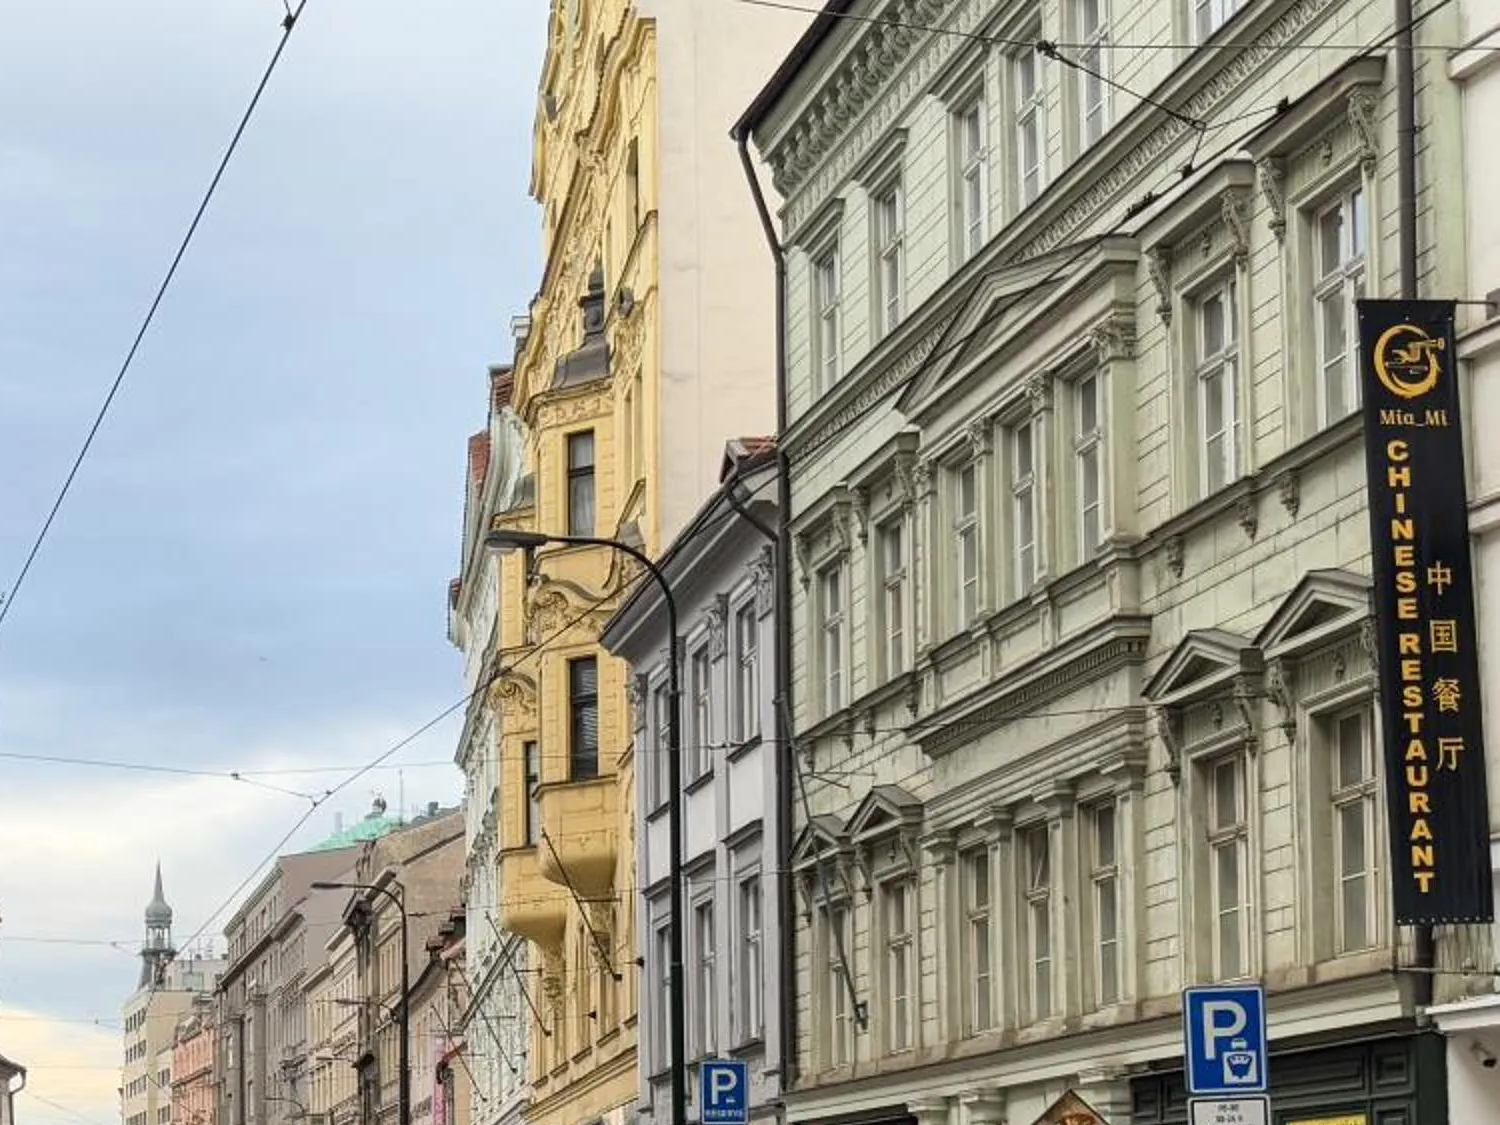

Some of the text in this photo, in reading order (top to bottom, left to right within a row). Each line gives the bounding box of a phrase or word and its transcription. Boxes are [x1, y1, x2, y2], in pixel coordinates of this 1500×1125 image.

[1379, 407, 1449, 428] Mia_Mi
[1387, 439, 1436, 893] CHINESE RESTAURANT
[1426, 560, 1466, 772] 中国餐厅
[1203, 1000, 1247, 1060] P
[712, 1068, 737, 1105] P
